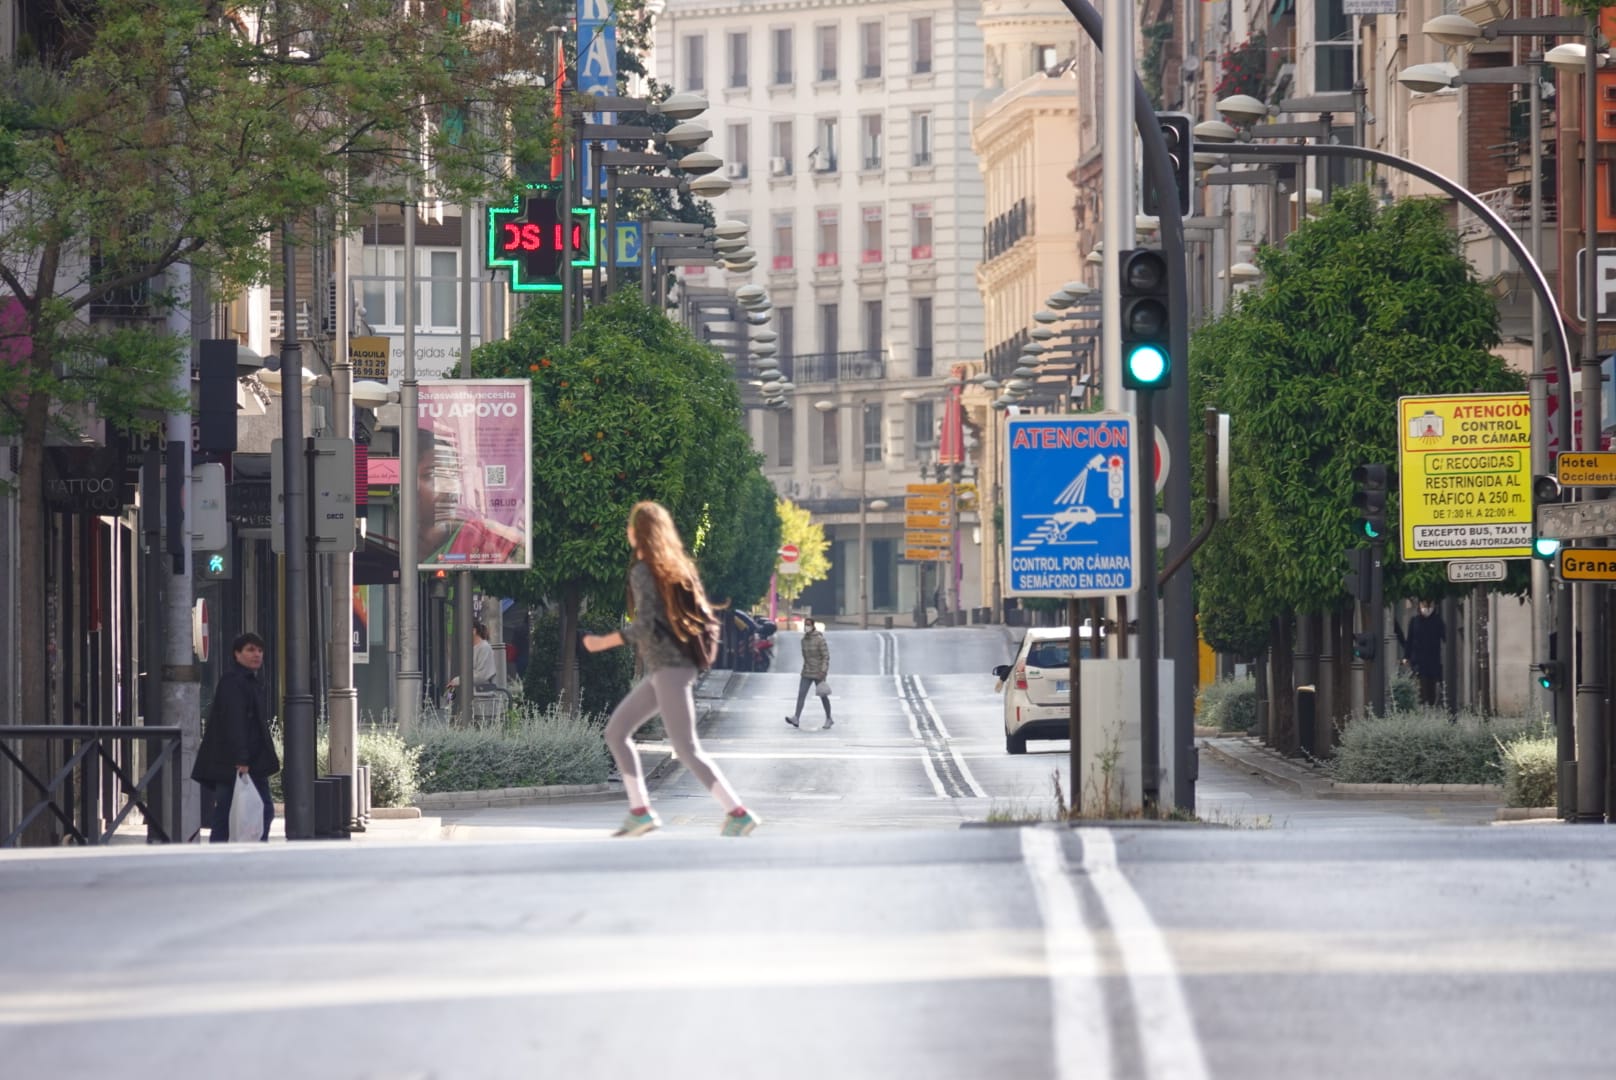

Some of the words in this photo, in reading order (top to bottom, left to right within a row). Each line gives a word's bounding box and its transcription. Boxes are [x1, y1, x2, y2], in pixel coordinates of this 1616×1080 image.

[352, 350, 386, 359] ALQUILA
[418, 390, 472, 400] Saraswathi
[475, 390, 516, 400] necesita
[418, 402, 444, 418] TU
[448, 402, 518, 418] APOYO
[1461, 420, 1522, 432] CONTROL
[1012, 422, 1128, 449] ATENCIÓN
[1452, 434, 1478, 444] POR
[1446, 456, 1514, 470] RECOGIDAS
[1561, 456, 1598, 468] Hotel
[48, 478, 114, 494] TATTOO
[1426, 476, 1502, 489] RESTRINGIDA
[1506, 475, 1520, 487] AL
[1424, 490, 1474, 506] TRÁFICO
[1478, 492, 1486, 504] A
[1489, 491, 1508, 504] 250
[1512, 493, 1526, 503] m.
[1433, 510, 1445, 519] DE
[1447, 509, 1464, 518] 7:30
[1476, 508, 1482, 517] A
[1485, 508, 1506, 518] 22:00
[1421, 528, 1466, 537] EXCEPTO
[1470, 526, 1492, 536] BUS,
[1496, 526, 1518, 534] TAXI
[1013, 557, 1060, 572] CONTROL
[1063, 556, 1084, 570] POR
[1087, 553, 1130, 570] CÁMARA
[1020, 572, 1077, 588] SEMÁFORO
[1080, 574, 1094, 588] EN
[1096, 574, 1124, 587] ROJO
